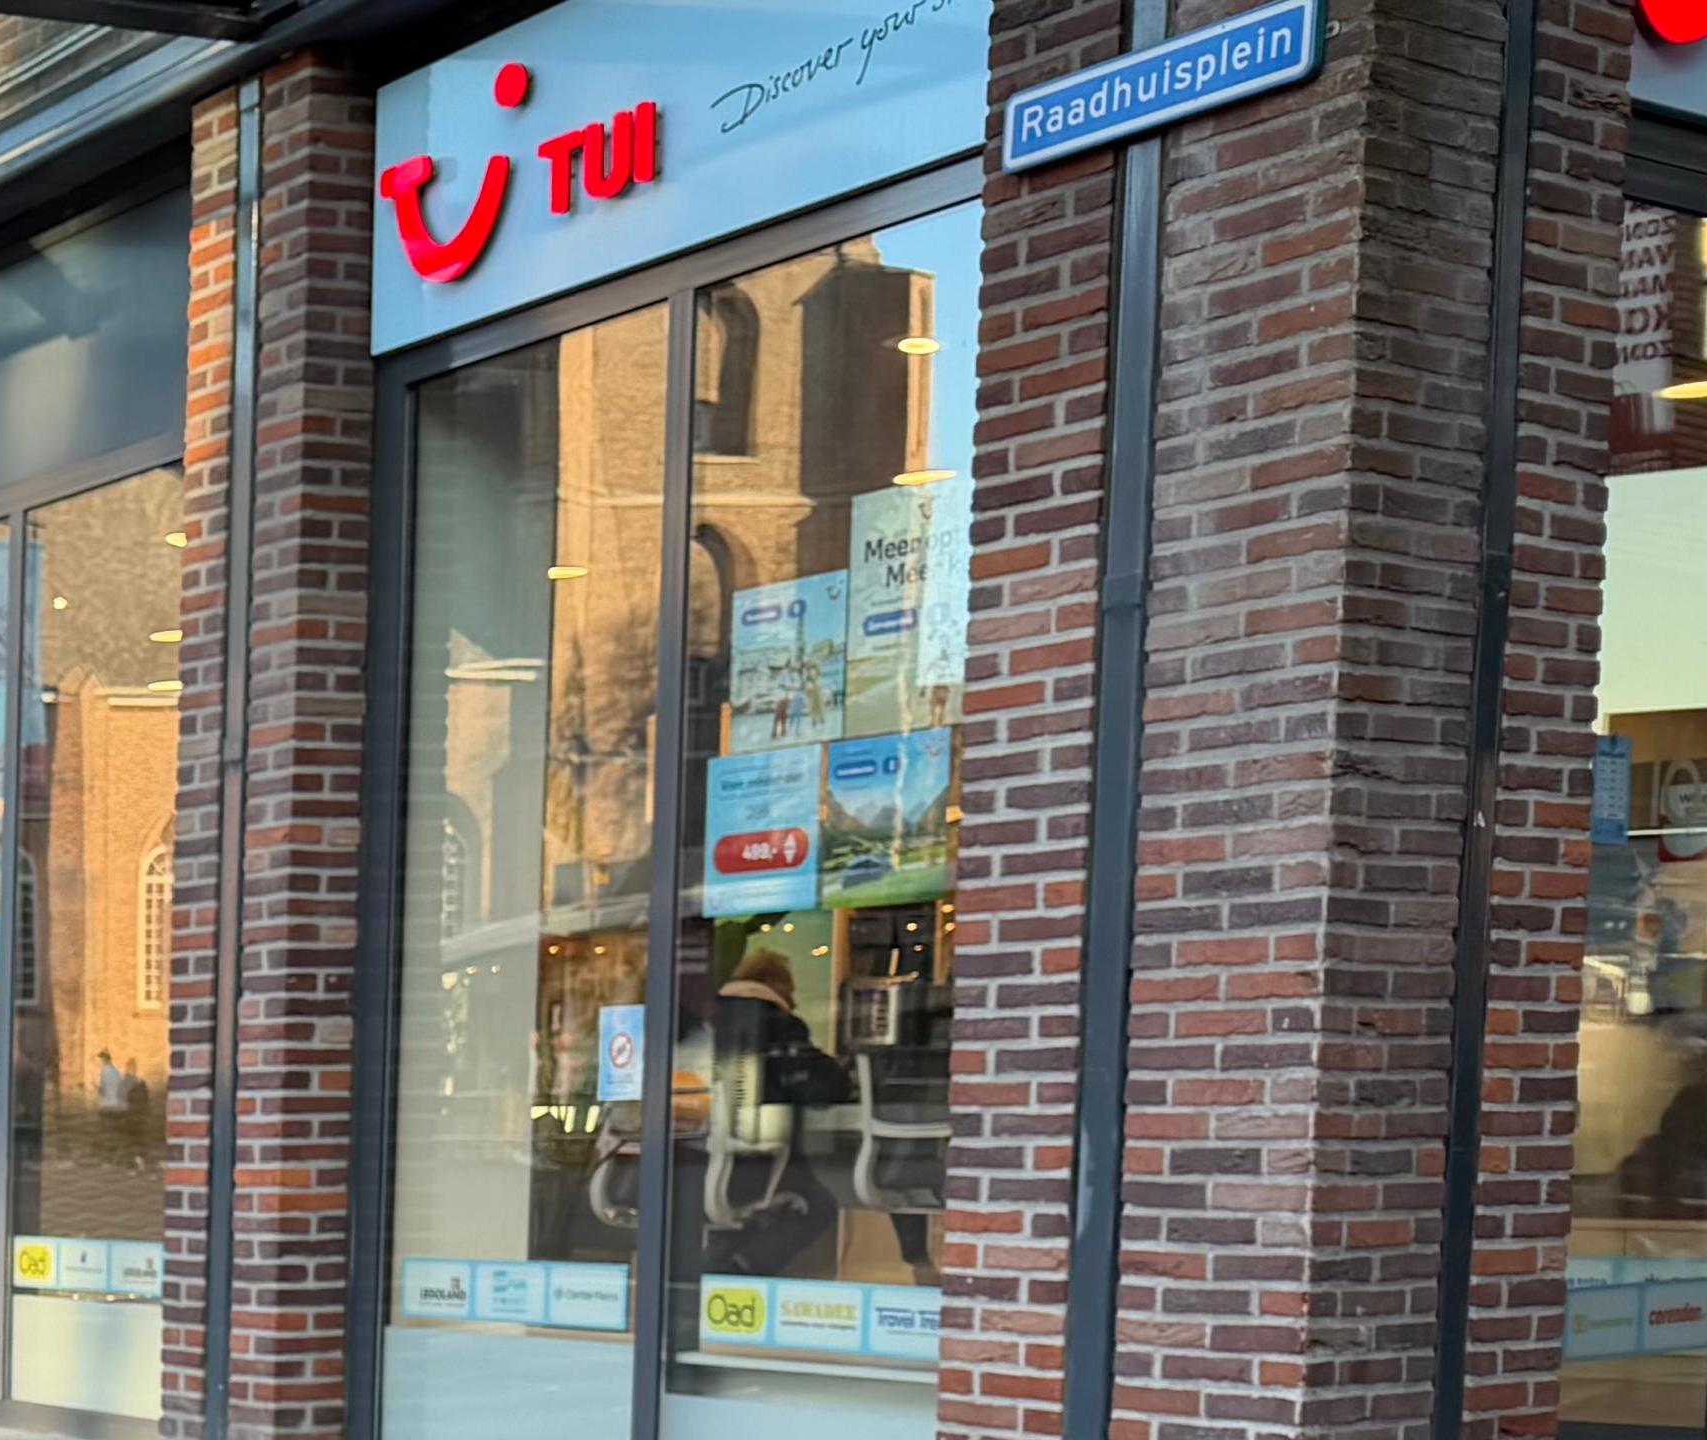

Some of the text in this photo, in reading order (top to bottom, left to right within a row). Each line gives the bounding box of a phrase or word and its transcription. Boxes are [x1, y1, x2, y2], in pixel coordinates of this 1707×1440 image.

[710, 0, 928, 134] Discover your
[1020, 25, 1292, 143] Raadhuisplein
[537, 100, 657, 216] TUI
[706, 1293, 756, 1328] Oad
